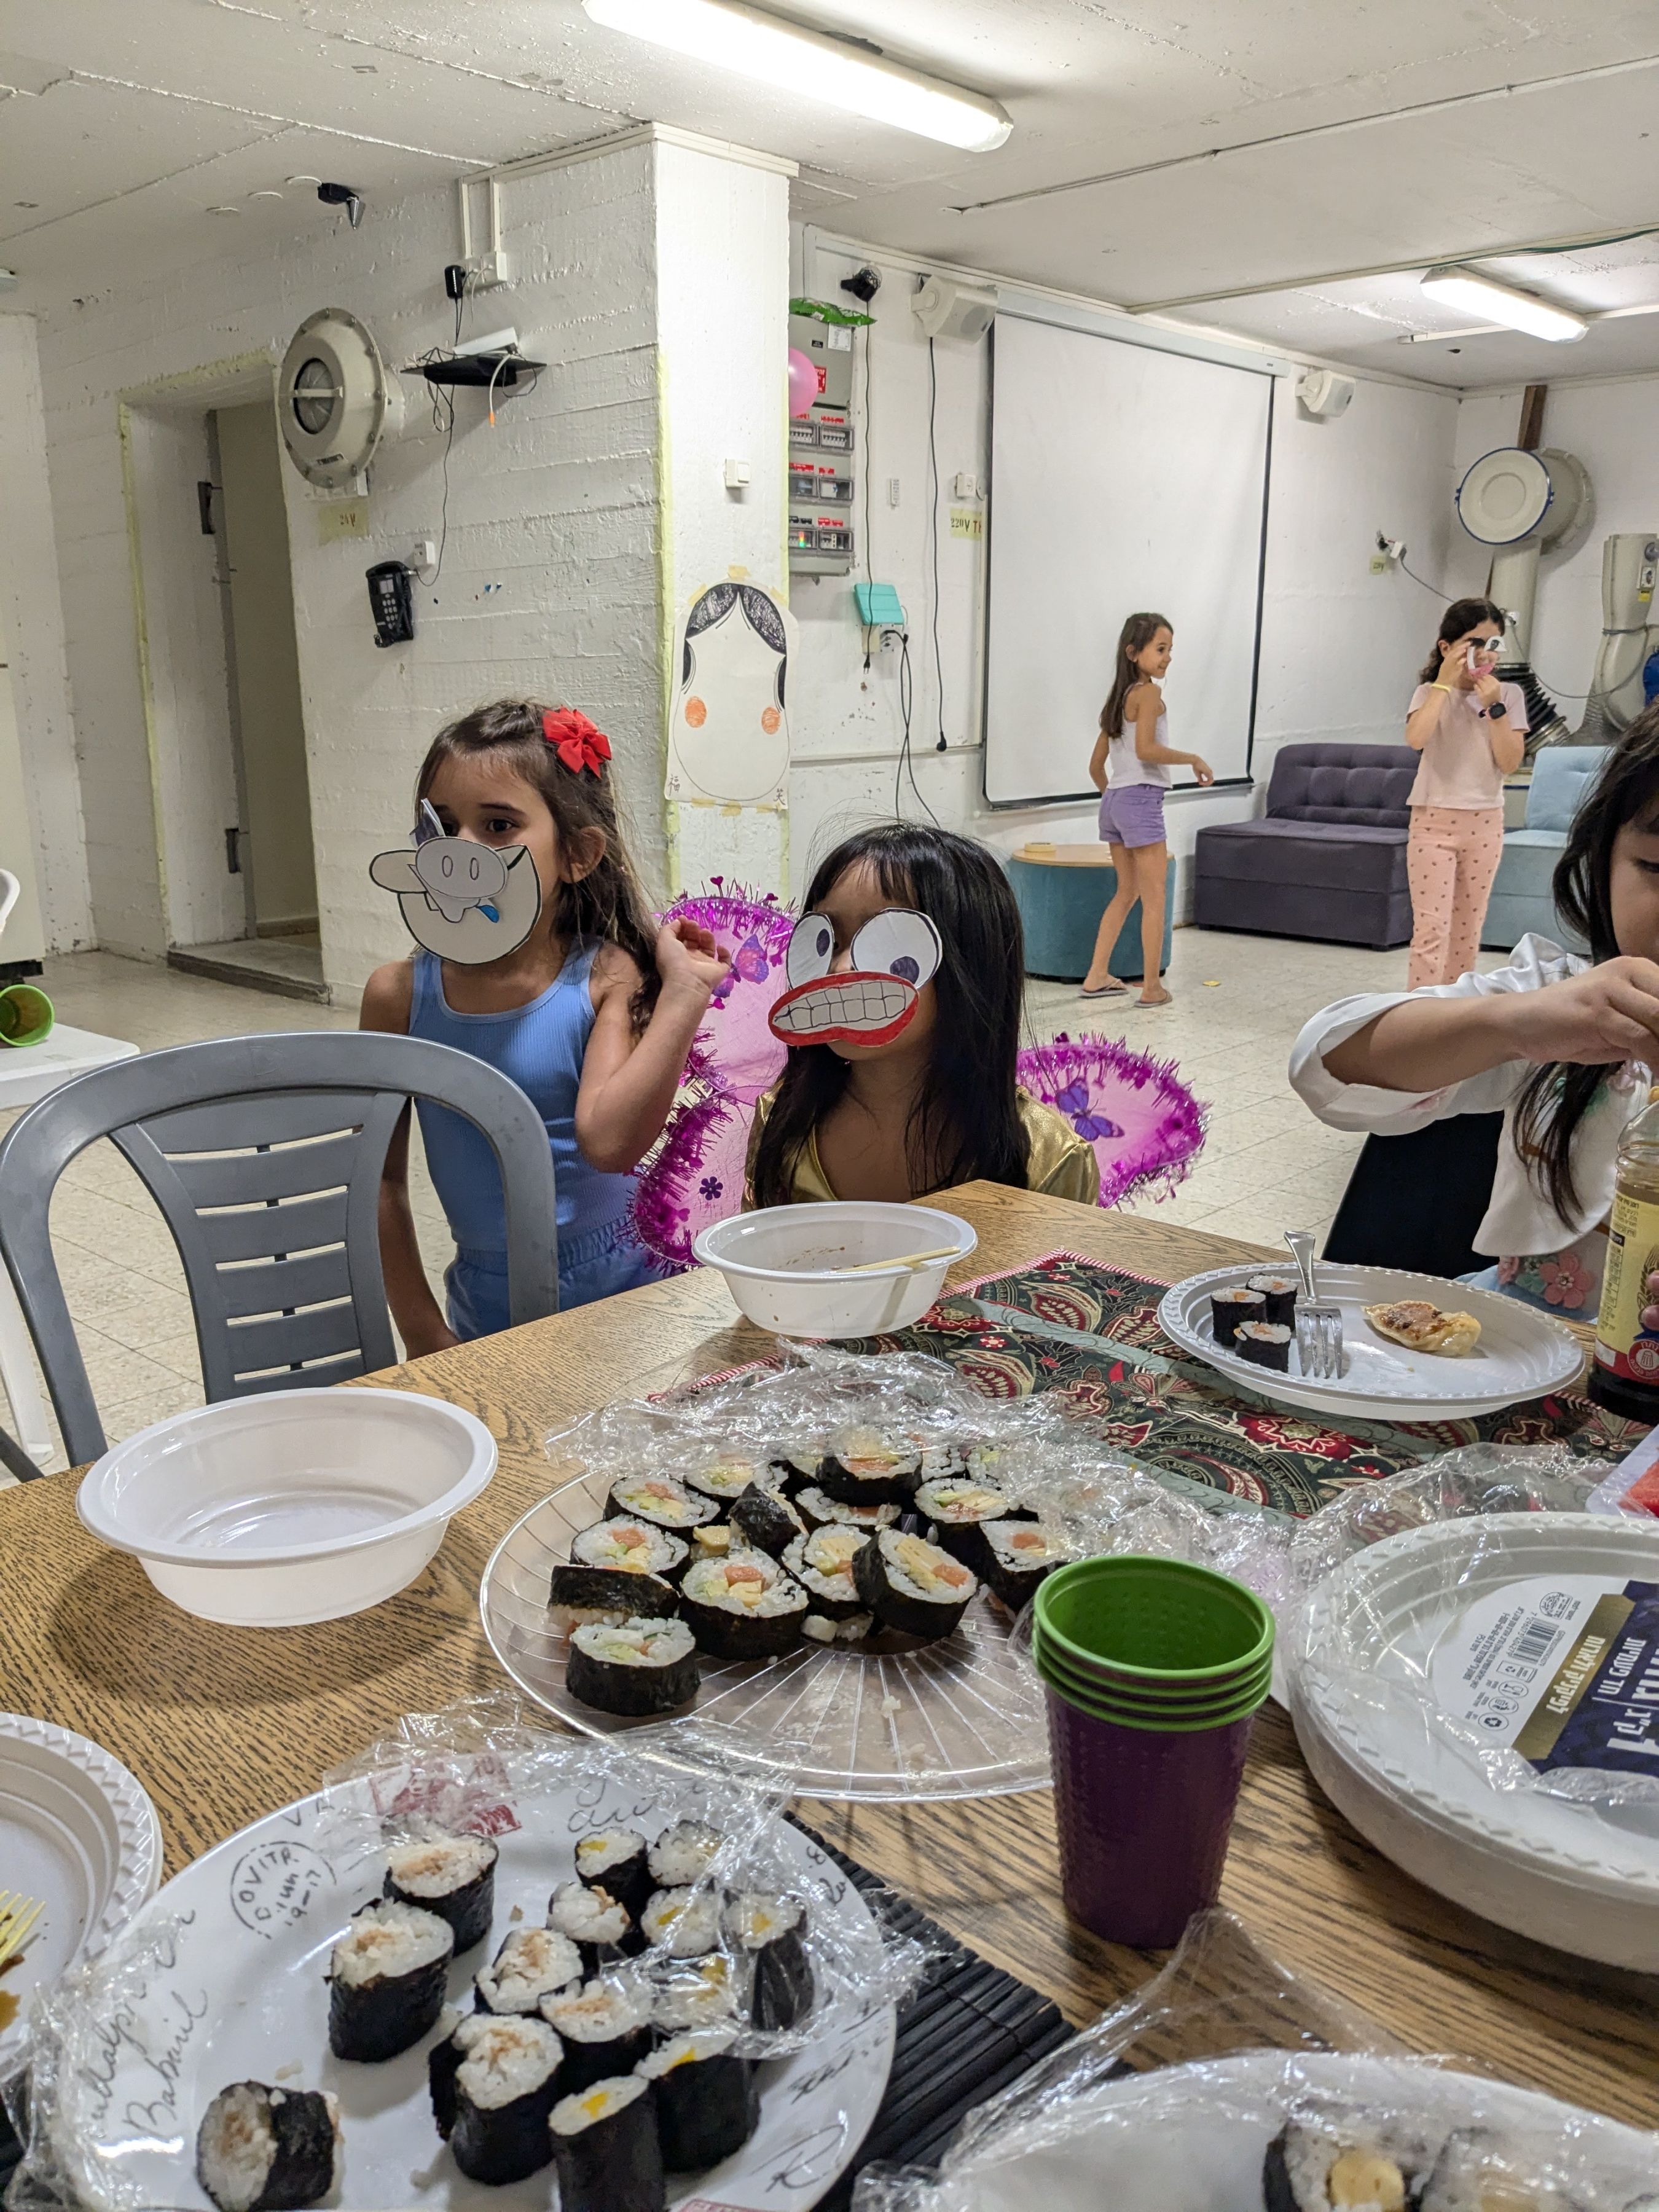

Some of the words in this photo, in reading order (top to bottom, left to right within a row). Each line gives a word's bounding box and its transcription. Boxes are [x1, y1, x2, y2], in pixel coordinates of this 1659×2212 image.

[950, 518, 970, 532] 220V
[1609, 1637, 1647, 1677] פעמיות
[1546, 1669, 1585, 1714] לפיקניק
[1598, 1679, 1625, 1695] חד
